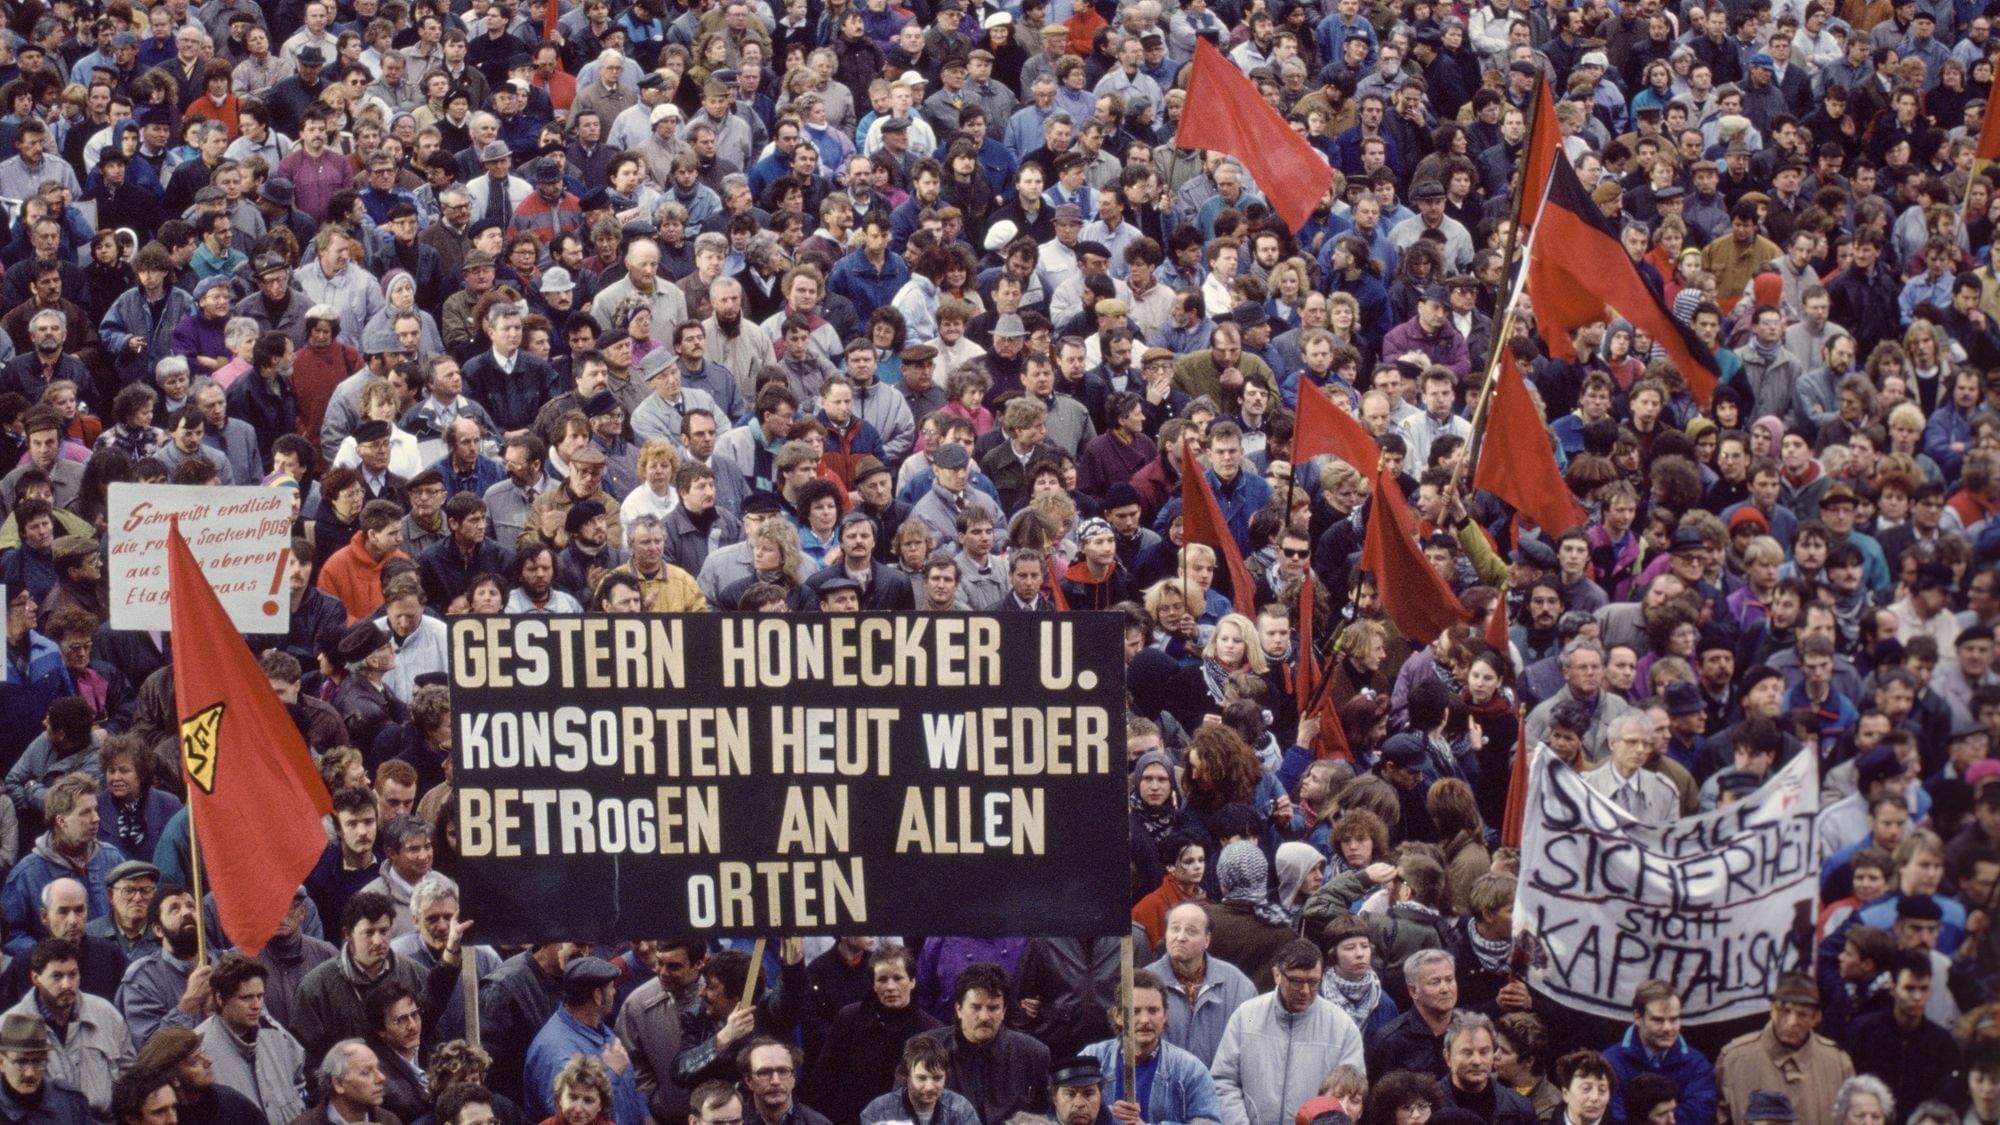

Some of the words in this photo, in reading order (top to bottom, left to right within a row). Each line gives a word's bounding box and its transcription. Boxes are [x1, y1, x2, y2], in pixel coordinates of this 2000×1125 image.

[217, 496, 282, 517] endlich
[112, 539, 138, 555] die
[197, 527, 256, 545] Socken
[126, 565, 161, 578] aus
[210, 551, 277, 569] oberen
[126, 586, 170, 606] Etag
[454, 618, 686, 690] GESTERN
[722, 616, 1001, 689] HONECKER
[1039, 621, 1098, 690] U.
[461, 705, 752, 776] KONSORTEN
[771, 706, 900, 777] HEUT
[921, 706, 1110, 777] WIEDER
[458, 785, 721, 858] BETROGEN
[777, 785, 850, 856] AN
[895, 786, 1045, 856] ALLEN
[687, 856, 868, 929] ORTEN
